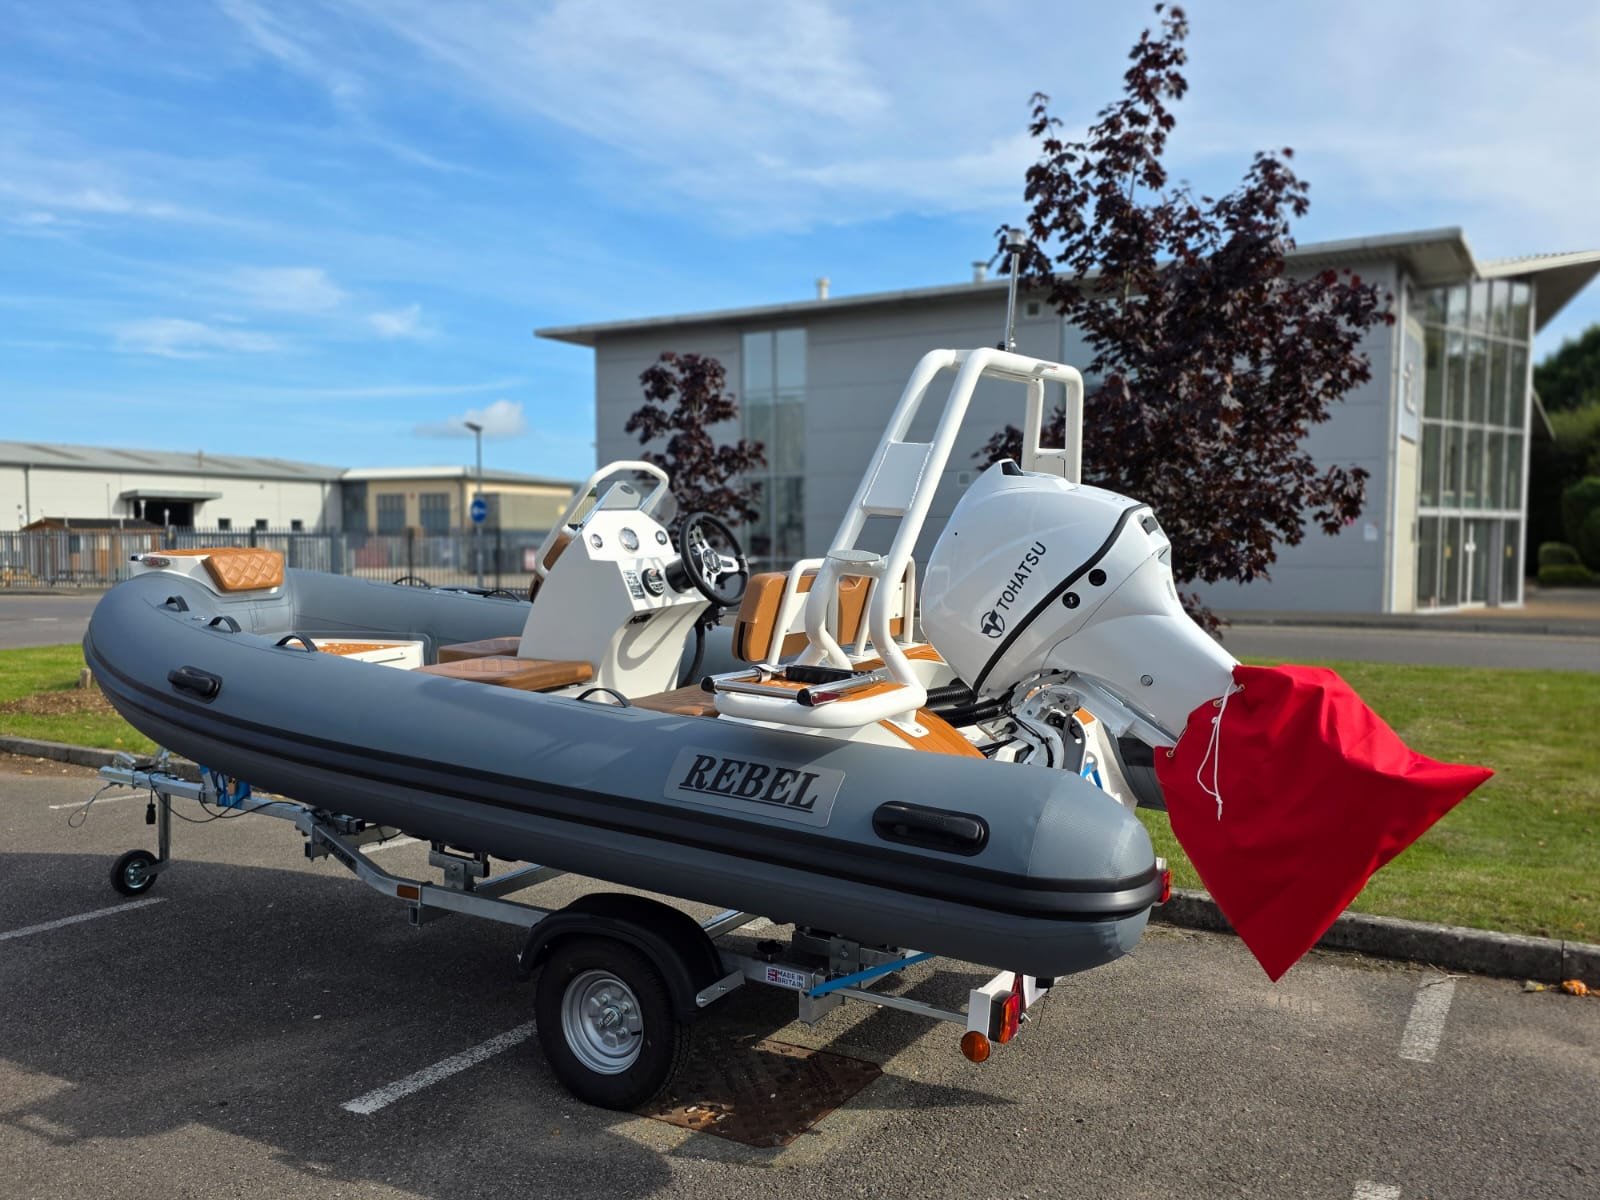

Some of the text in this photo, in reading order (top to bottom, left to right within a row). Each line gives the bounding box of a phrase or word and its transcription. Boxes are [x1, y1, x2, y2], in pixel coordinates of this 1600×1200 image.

[996, 541, 1047, 610] TOHATSU
[680, 754, 820, 809] REBEL
[777, 970, 804, 982] MADE IN
